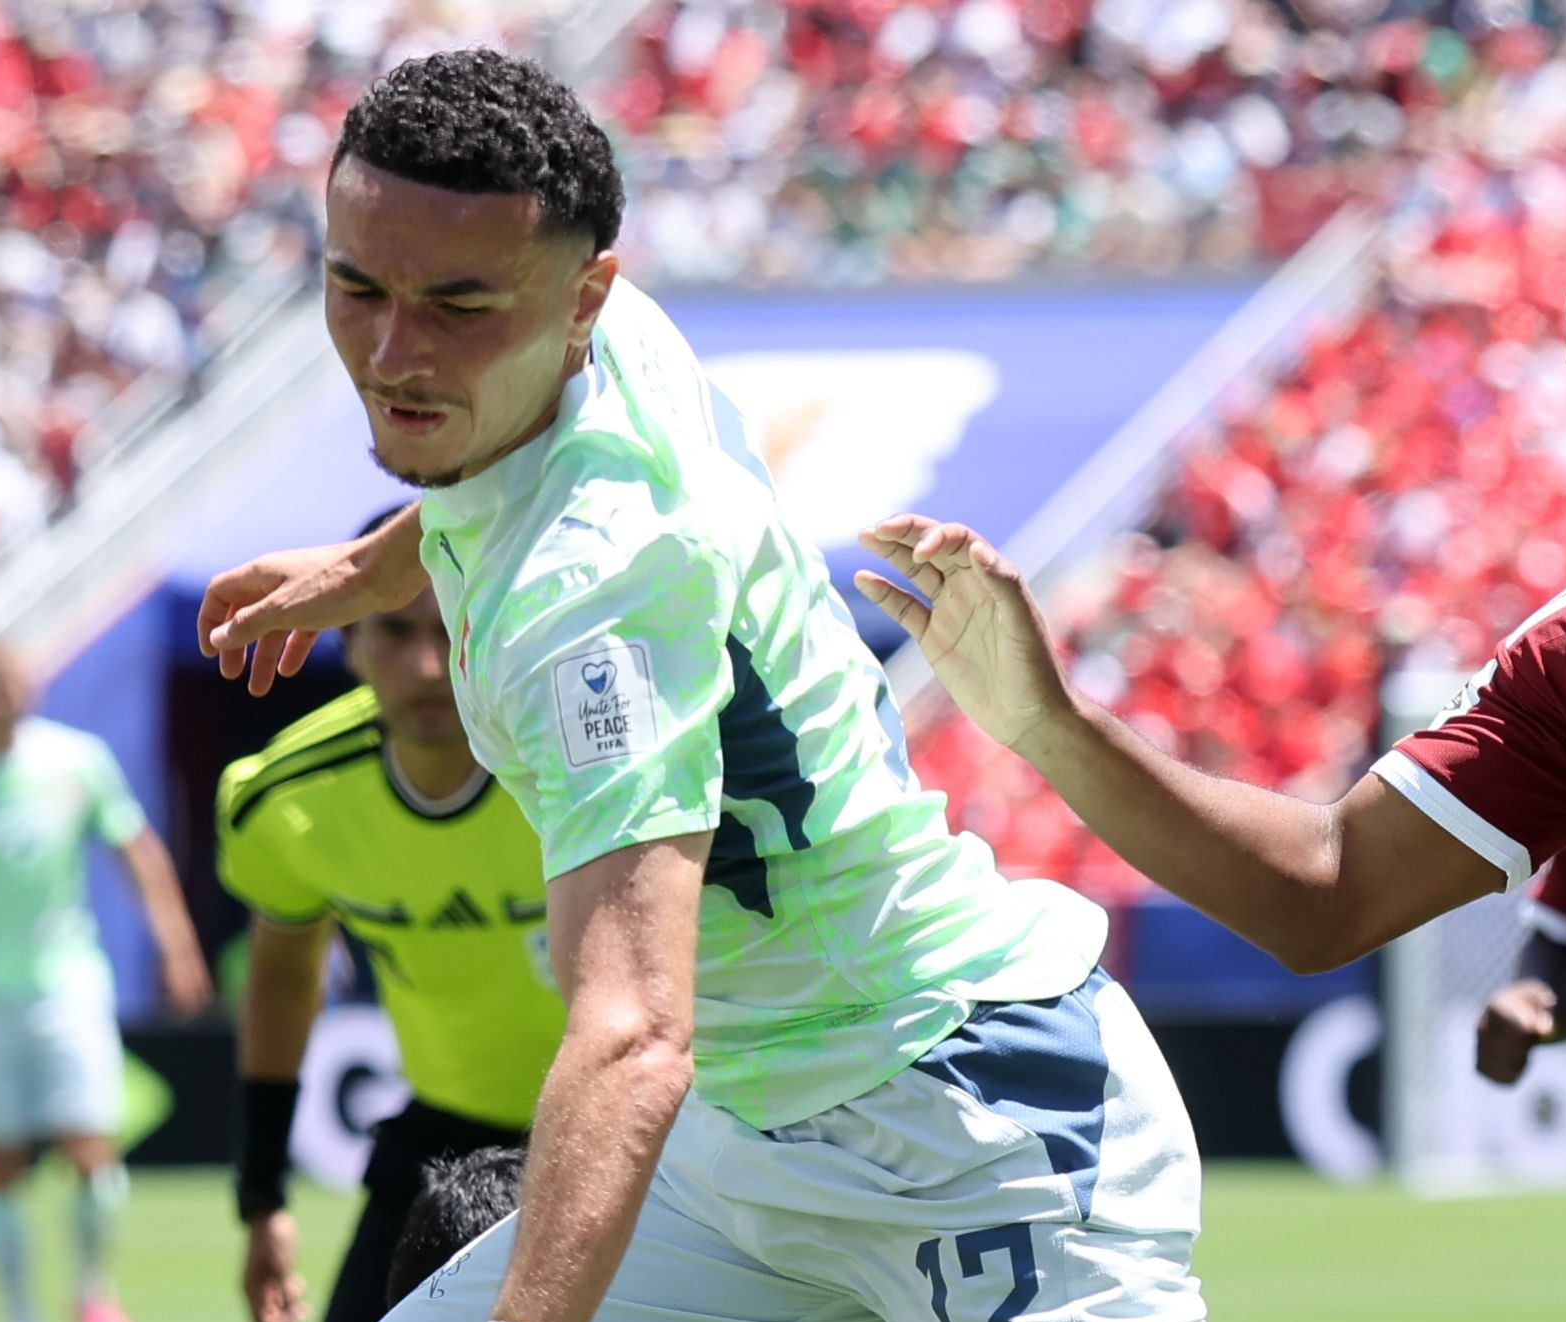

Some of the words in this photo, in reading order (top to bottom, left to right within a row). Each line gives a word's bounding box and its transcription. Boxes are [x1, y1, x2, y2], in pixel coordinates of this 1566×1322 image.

[577, 697, 611, 723] Unite
[611, 693, 632, 713] For
[584, 715, 632, 743] PEACE
[596, 738, 625, 753] FIFA
